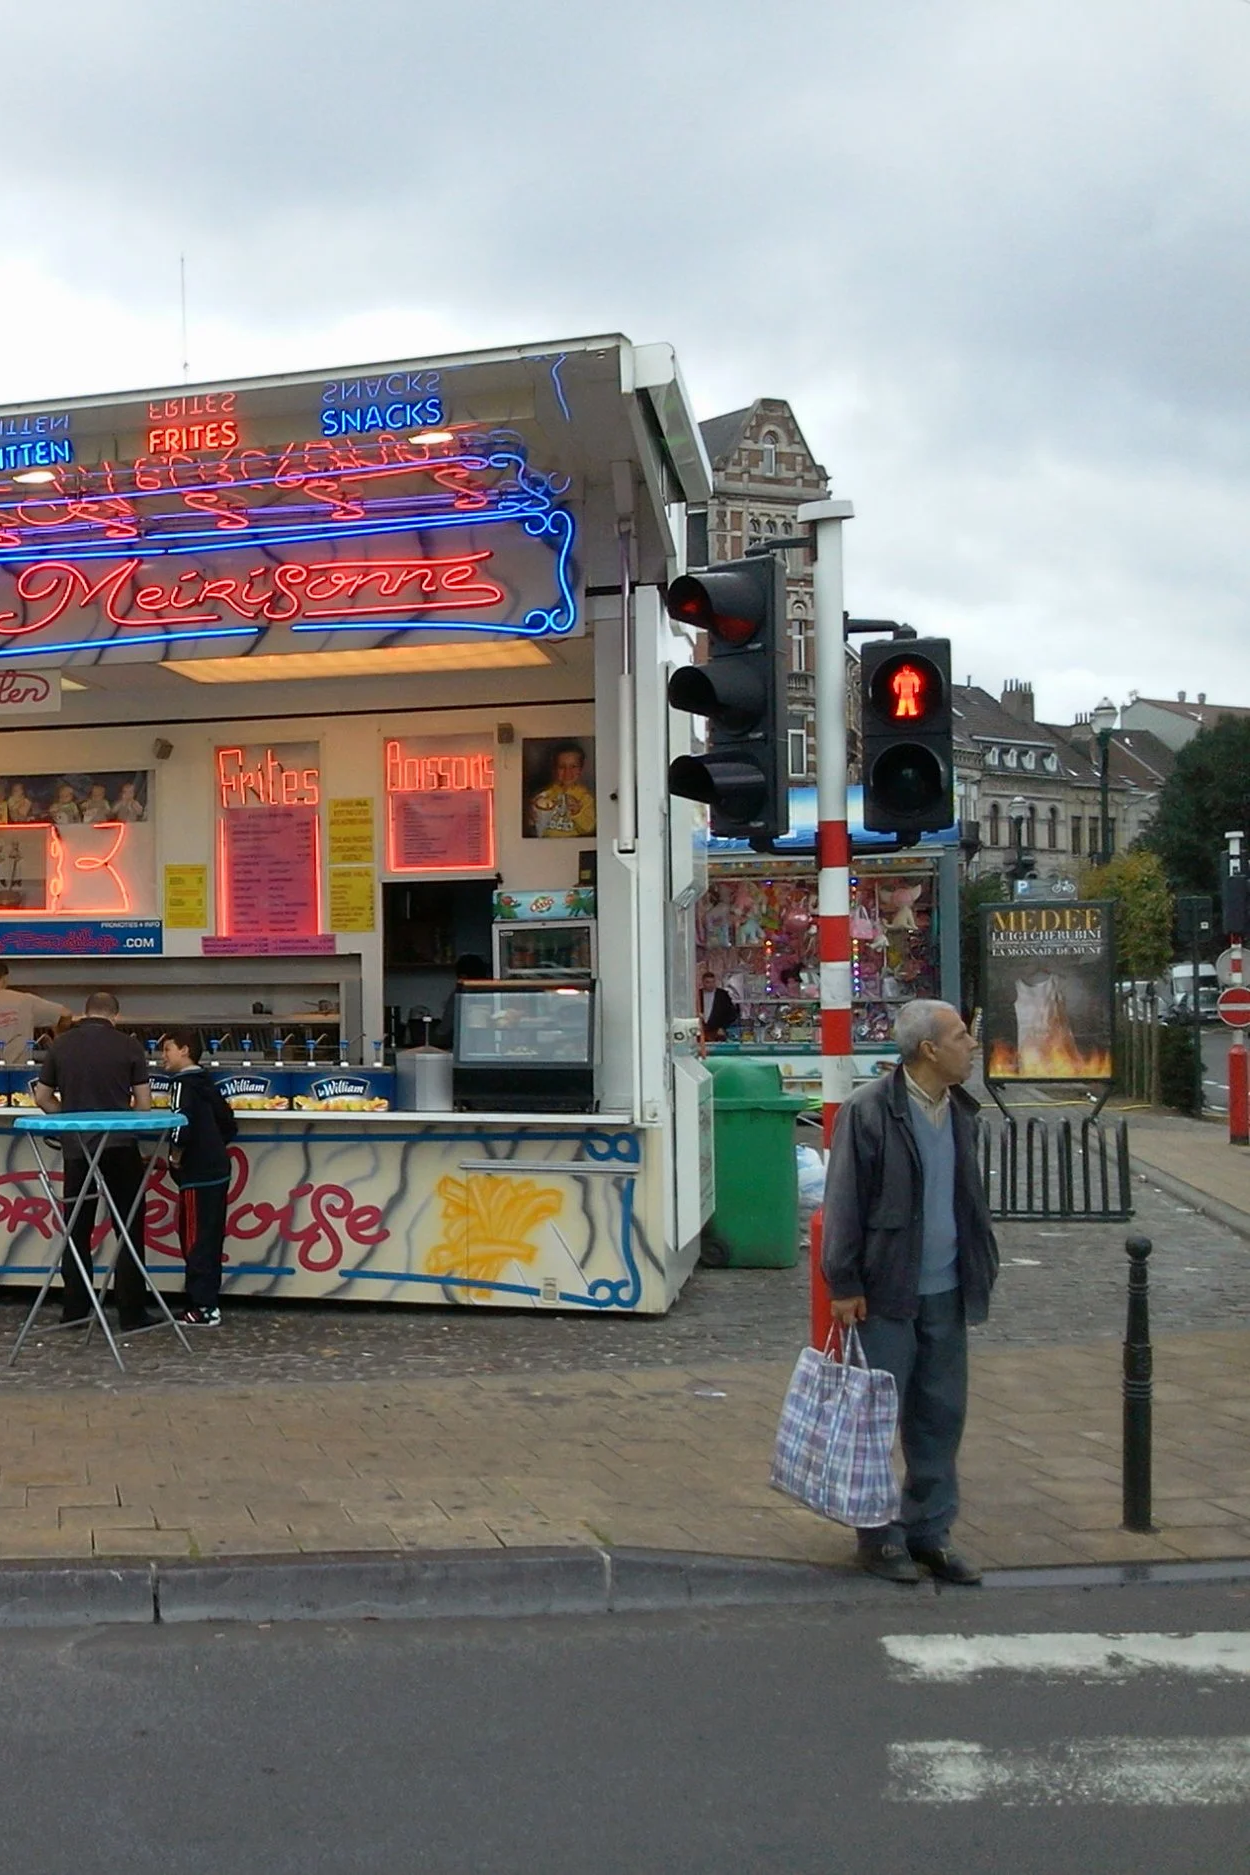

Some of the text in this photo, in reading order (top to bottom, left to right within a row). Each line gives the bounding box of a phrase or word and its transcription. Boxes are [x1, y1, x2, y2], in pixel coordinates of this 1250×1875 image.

[321, 398, 442, 435] SNACKS
[149, 421, 238, 453] FRITES
[992, 930, 1101, 942] LUIGI CHERUBINI
[225, 1078, 265, 1095] William
[324, 1078, 364, 1095] William
